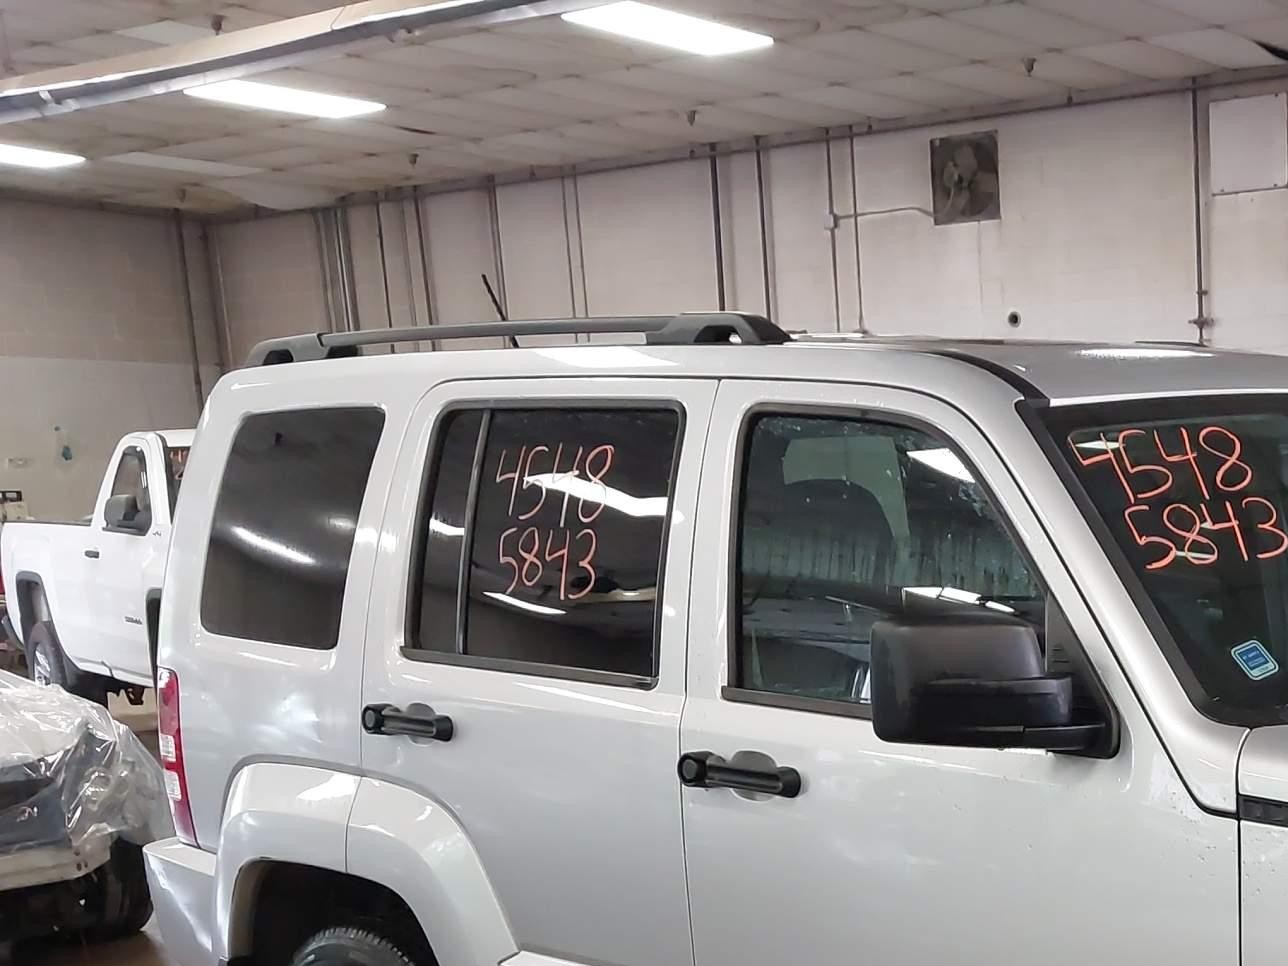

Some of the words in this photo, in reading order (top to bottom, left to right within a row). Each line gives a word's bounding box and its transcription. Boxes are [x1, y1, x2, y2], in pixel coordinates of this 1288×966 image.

[495, 443, 615, 527] 4548
[1067, 426, 1252, 504] 4548
[498, 527, 597, 600] 5843
[1123, 497, 1288, 569] 5843
